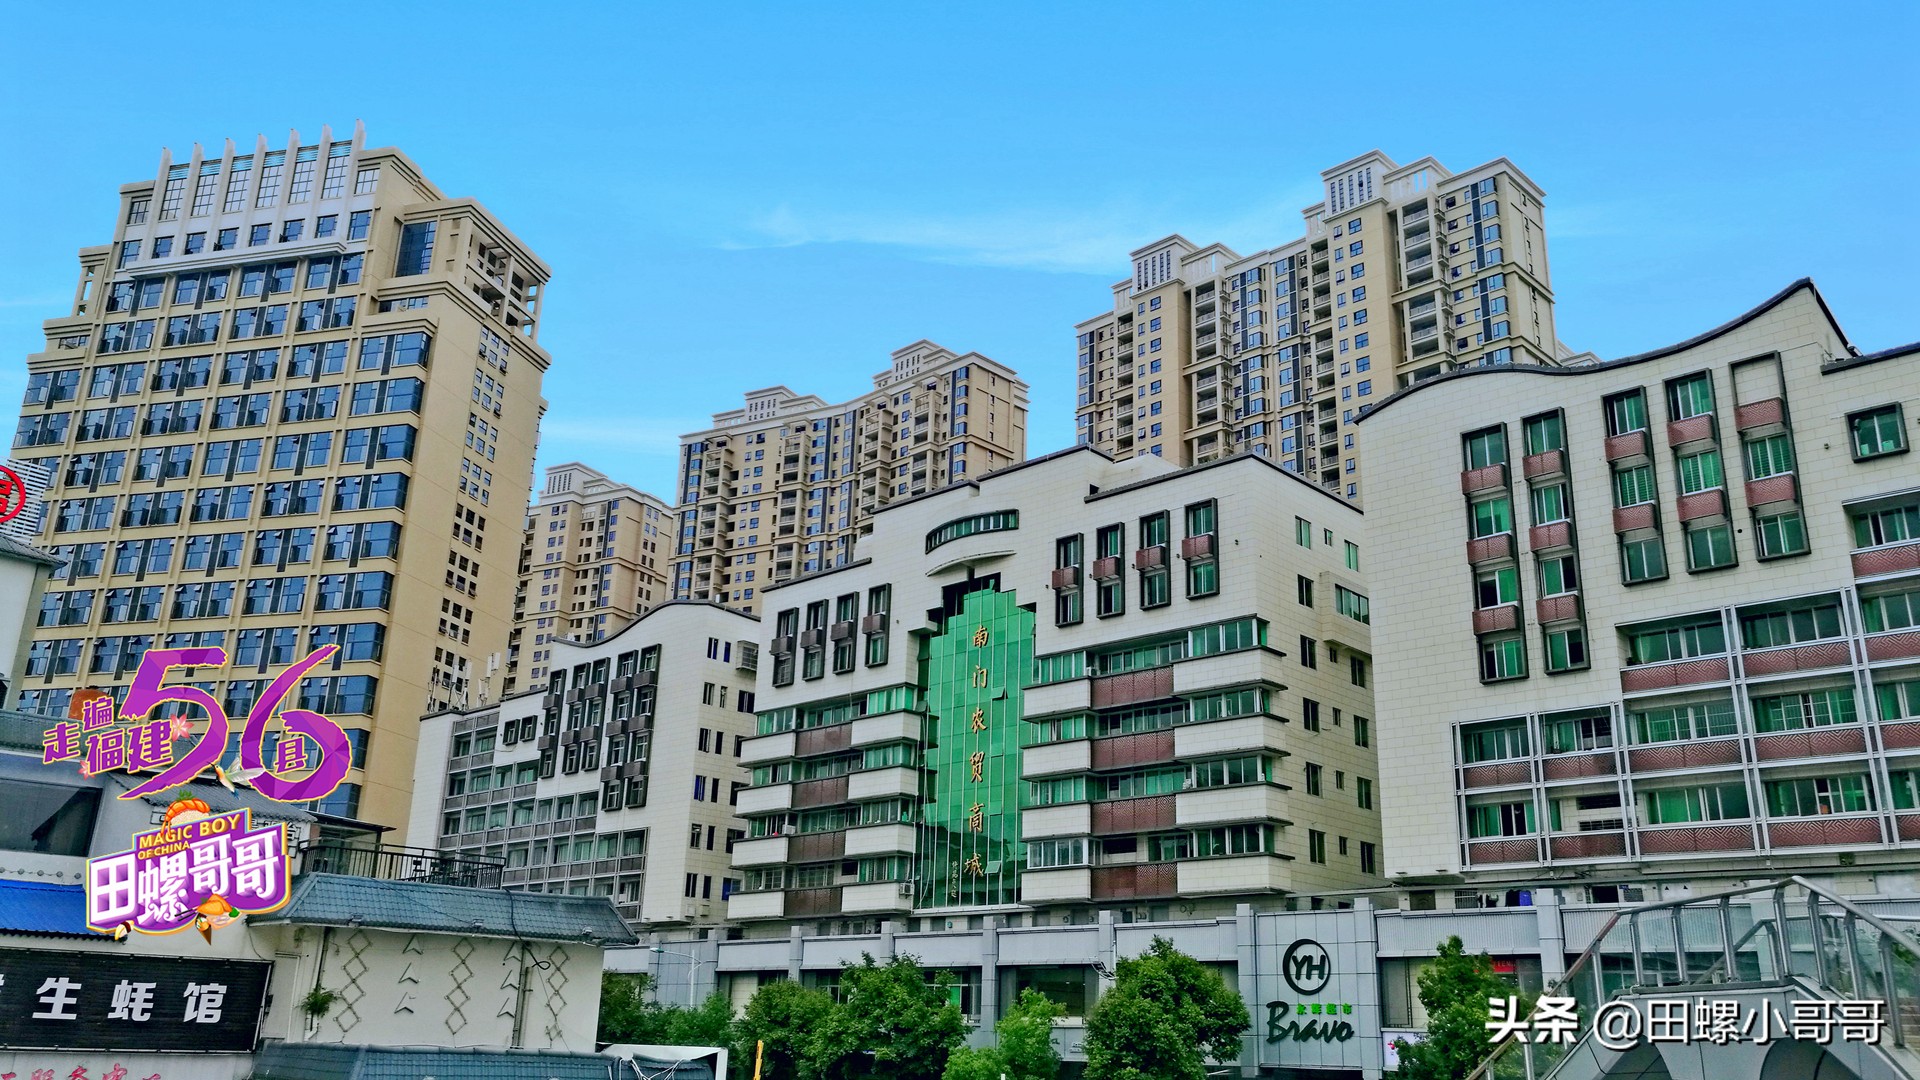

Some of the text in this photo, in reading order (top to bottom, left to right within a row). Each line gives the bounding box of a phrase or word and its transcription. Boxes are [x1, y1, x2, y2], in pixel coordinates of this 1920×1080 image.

[963, 624, 989, 878] 南门农贸商城
[1291, 954, 1327, 981] YH
[0, 973, 228, 1024] 生蚝馆
[1266, 1001, 1355, 1044] Bravo
